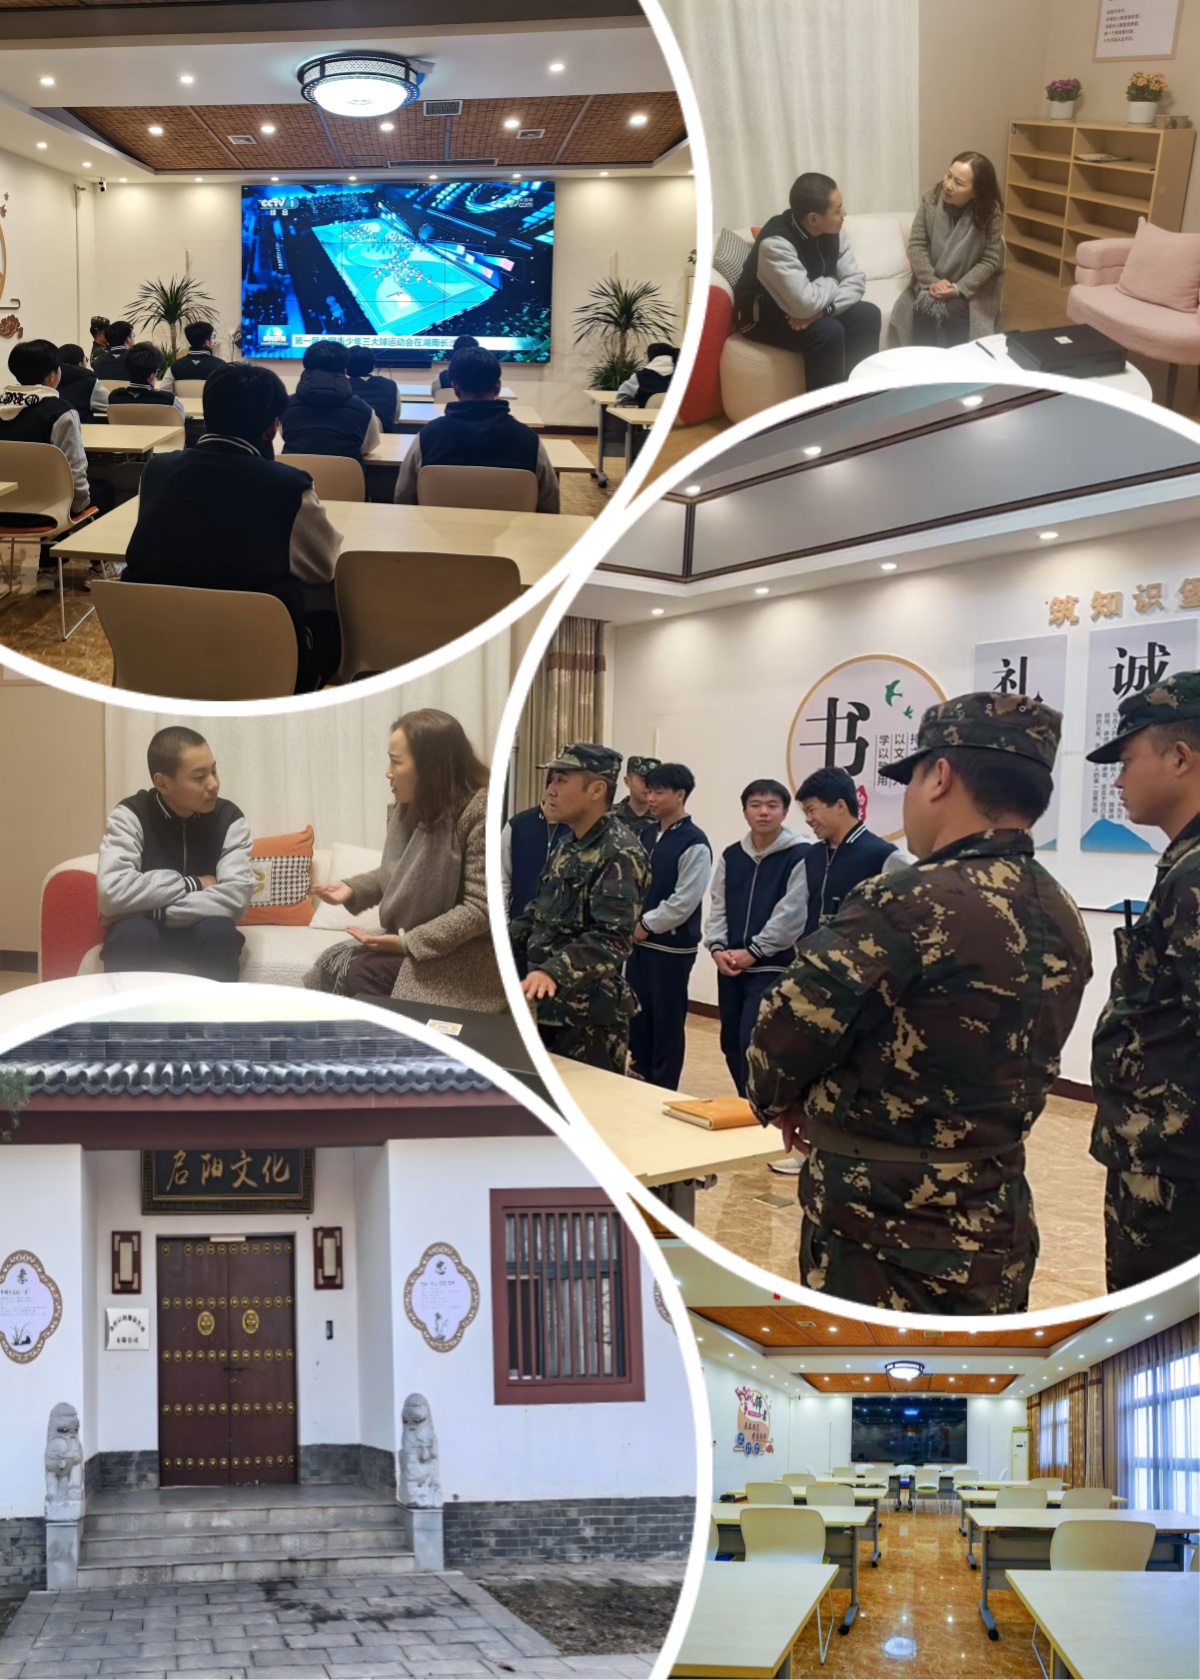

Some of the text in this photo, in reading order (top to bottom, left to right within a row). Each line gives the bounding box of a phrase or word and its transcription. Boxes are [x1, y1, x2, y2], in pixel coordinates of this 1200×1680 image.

[261, 199, 286, 207] CCTV
[1109, 642, 1171, 700] 诚
[800, 697, 870, 776] 书
